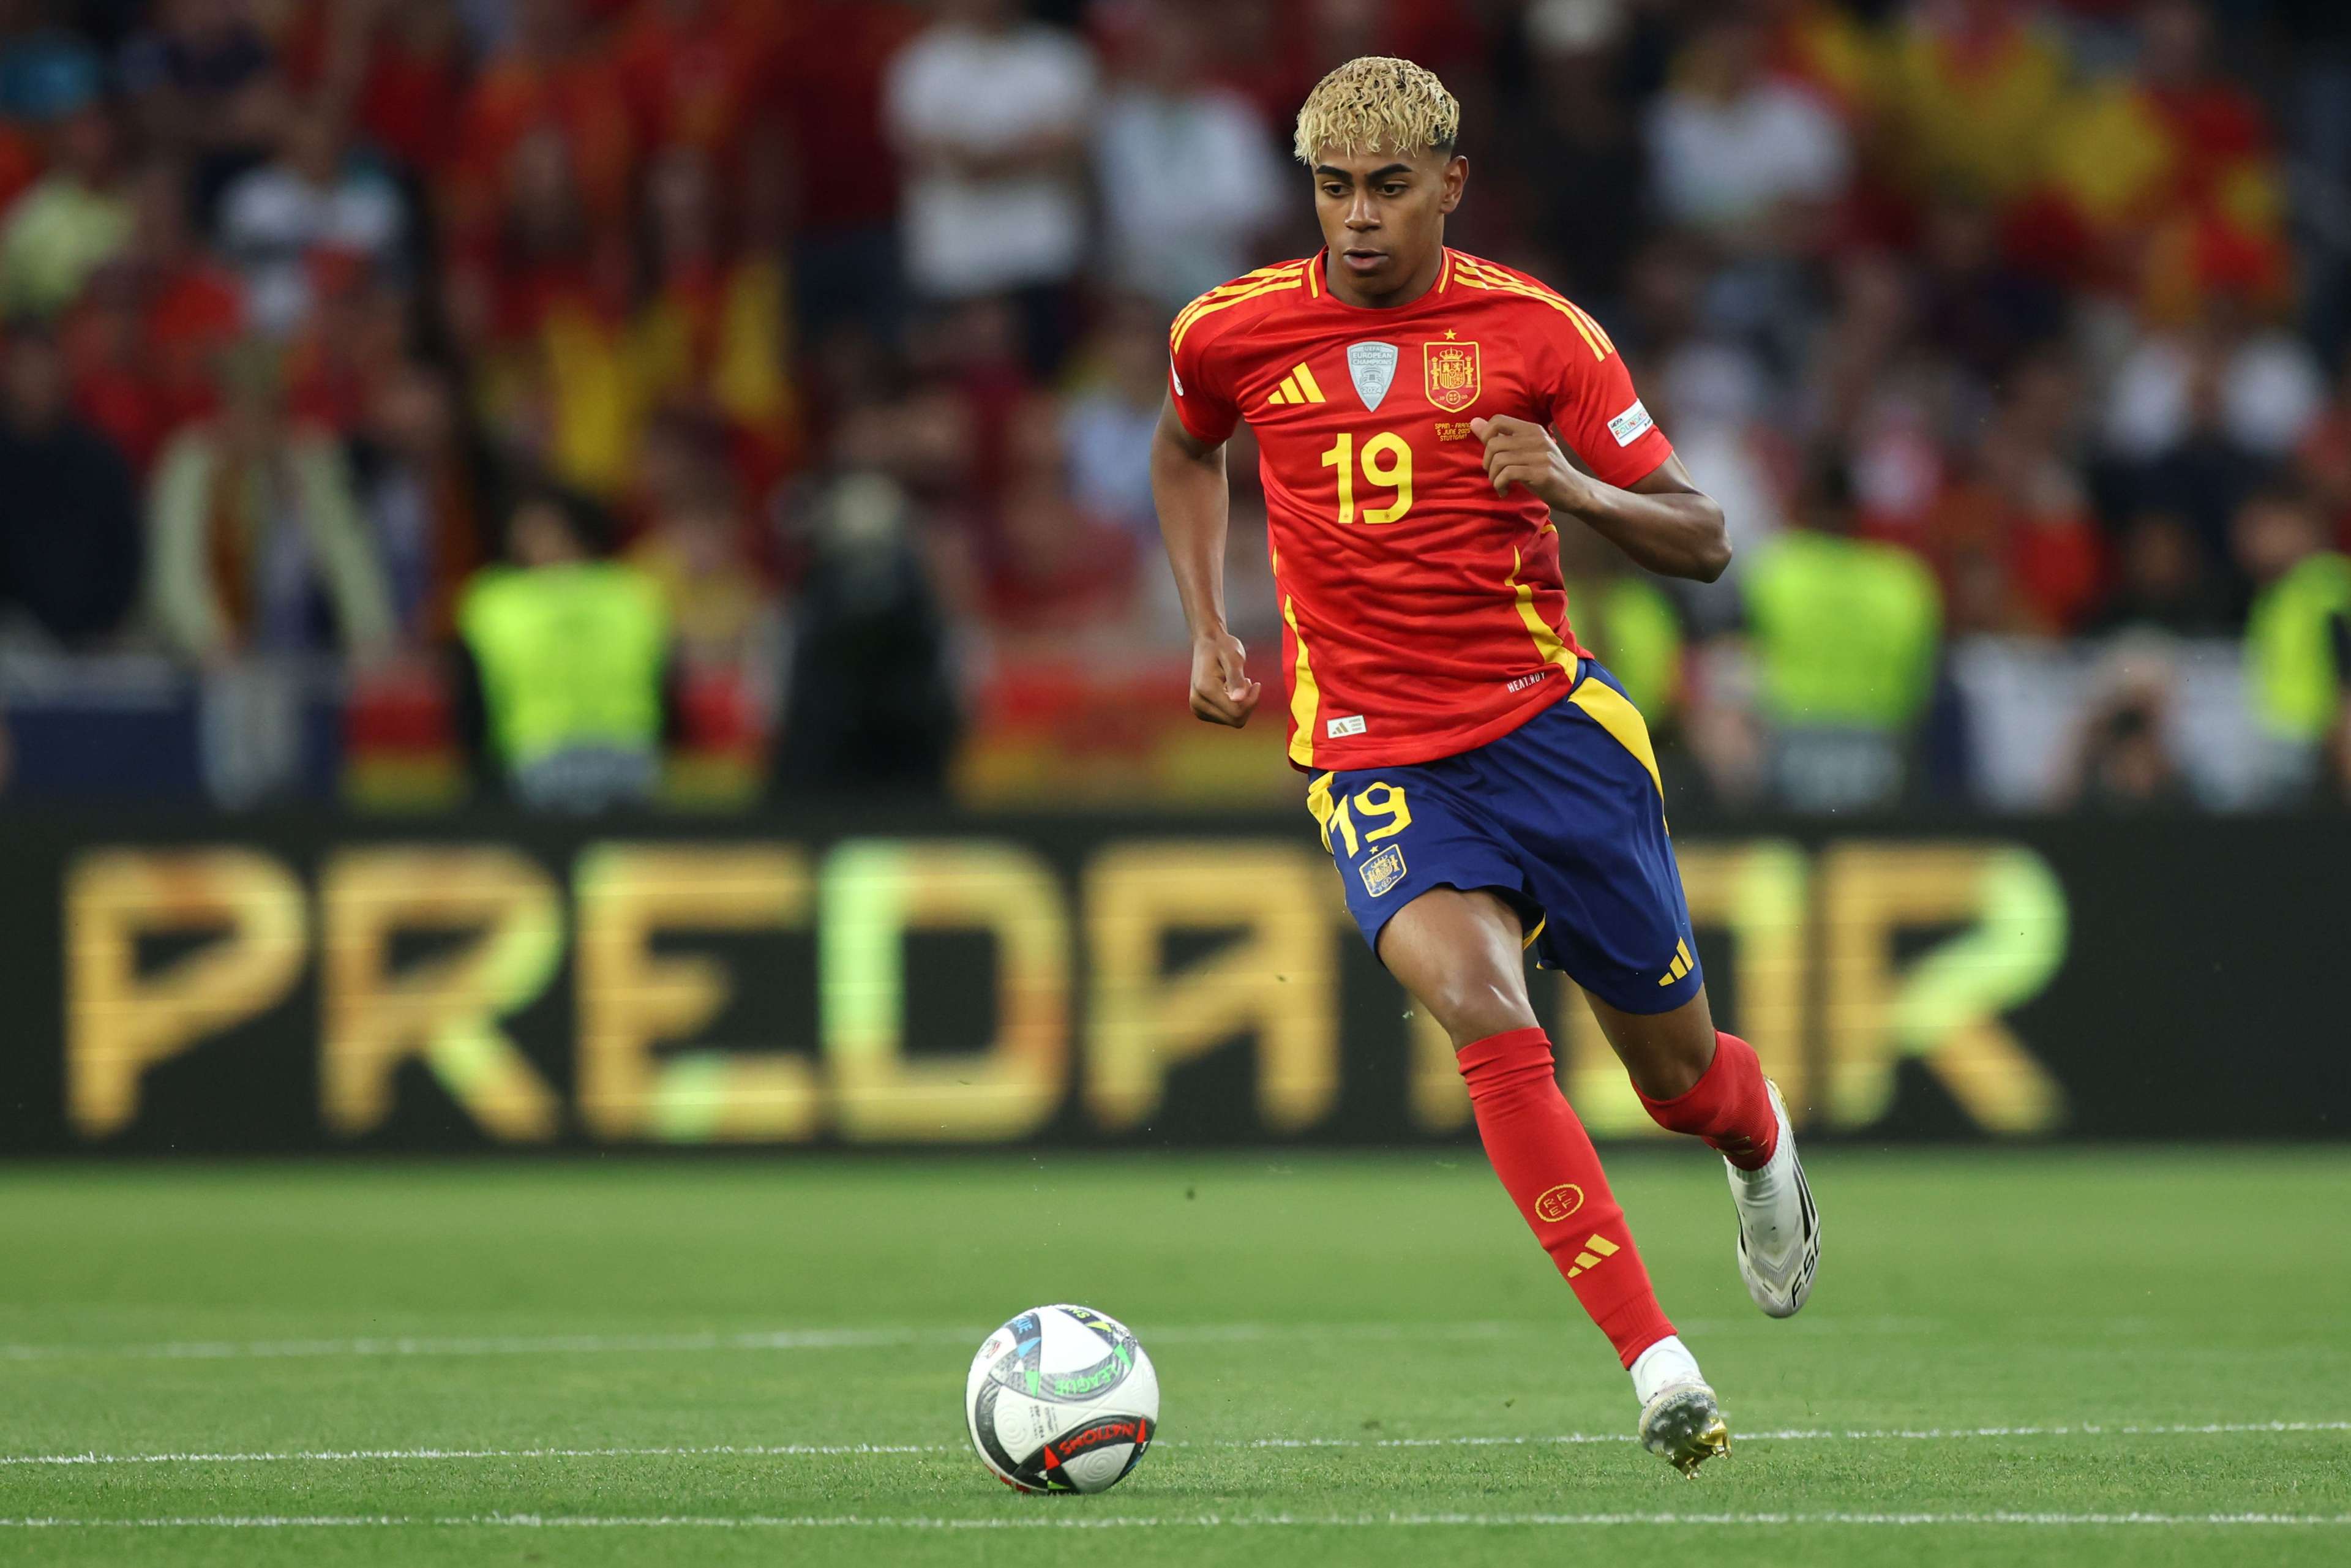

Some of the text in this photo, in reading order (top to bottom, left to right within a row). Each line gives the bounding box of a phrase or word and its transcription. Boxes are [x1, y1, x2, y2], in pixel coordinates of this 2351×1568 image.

[1322, 432, 1413, 524] 19
[1330, 781, 1412, 859] 19
[1054, 1364, 1119, 1396] LEAGUE
[1059, 1422, 1136, 1455] NATIONS
